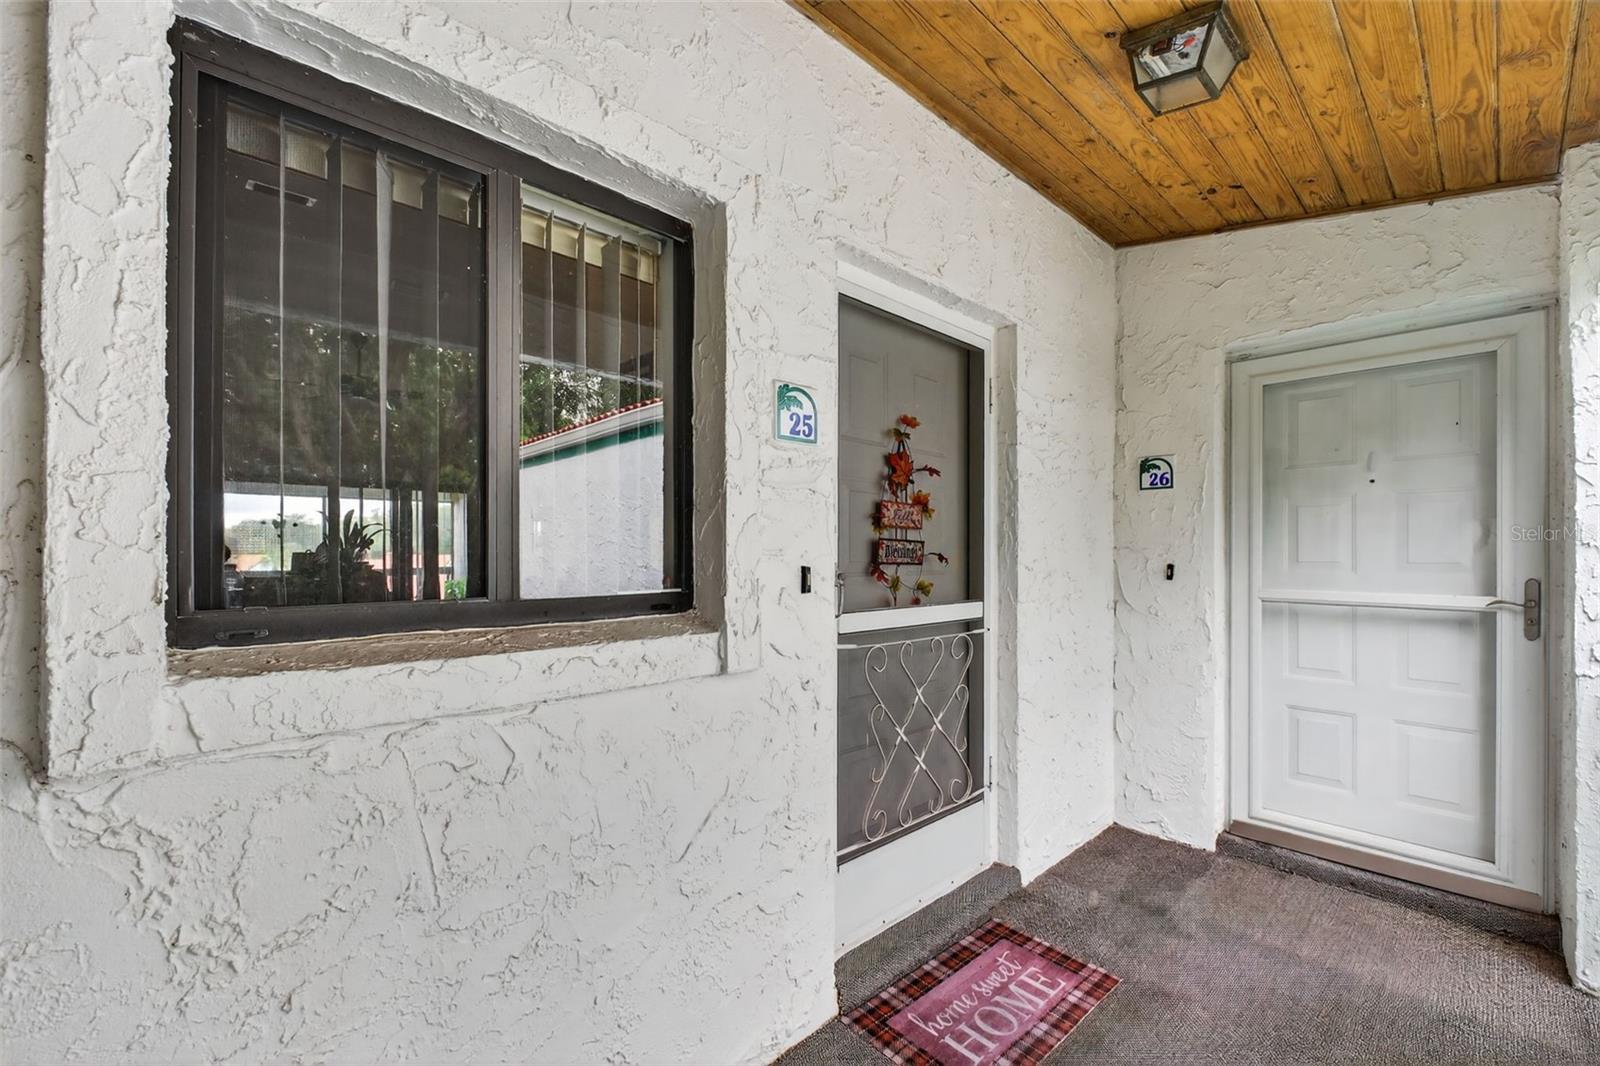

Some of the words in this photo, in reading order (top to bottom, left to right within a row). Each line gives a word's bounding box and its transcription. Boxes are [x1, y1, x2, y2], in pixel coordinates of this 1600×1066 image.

[789, 412, 813, 438] 25
[1148, 471, 1170, 487] 26
[907, 991, 979, 1037] home
[971, 950, 1022, 997] sweet
[938, 966, 1067, 1066] HOME
